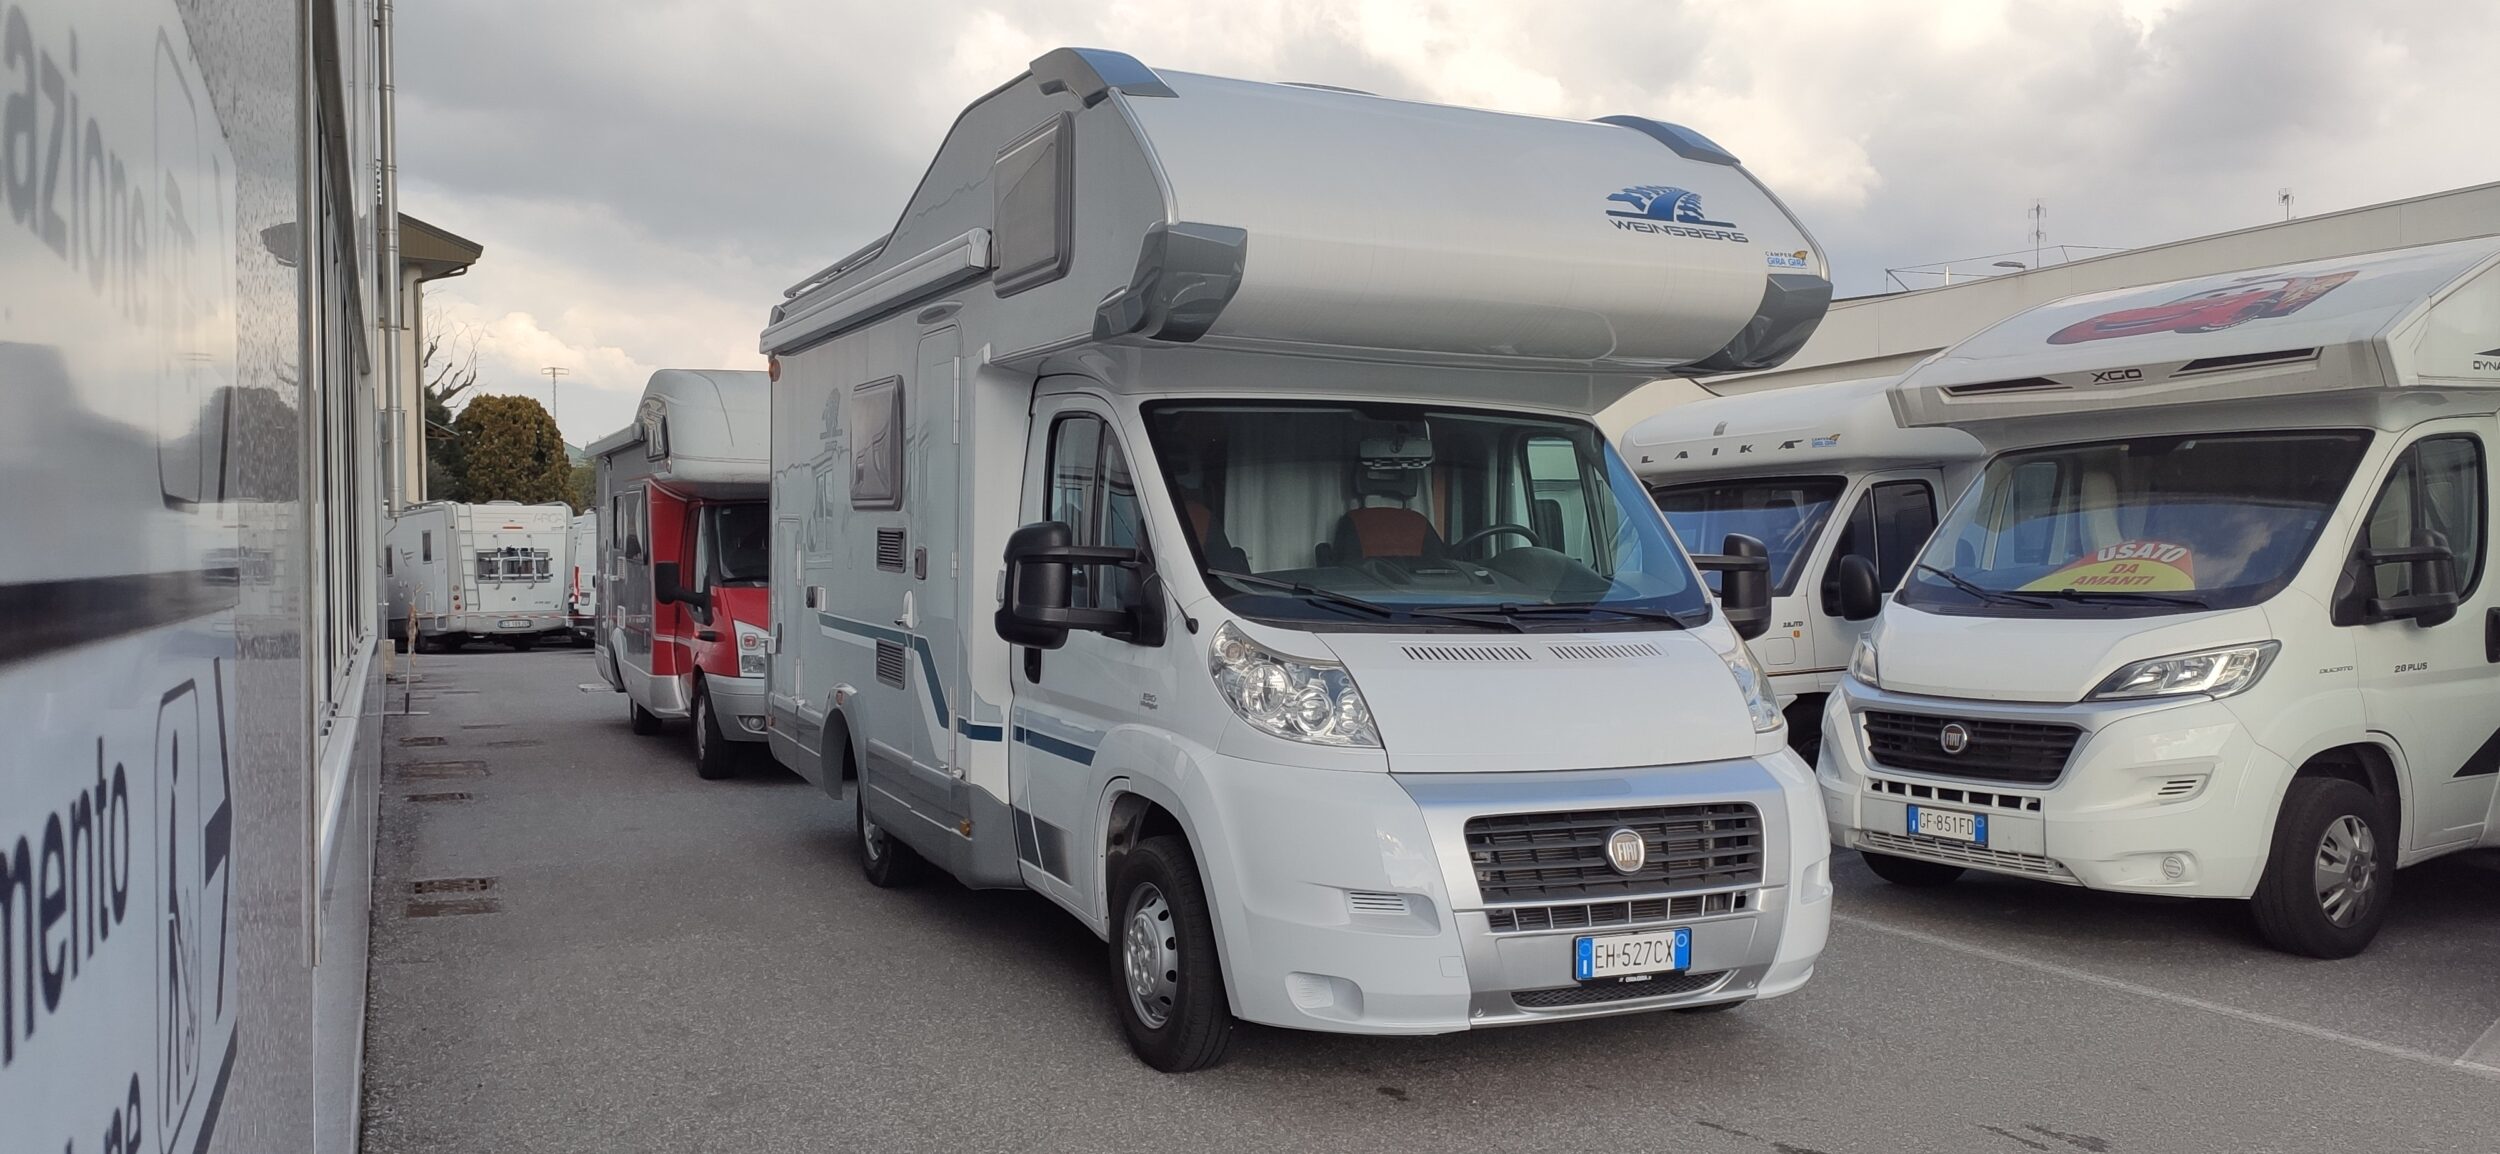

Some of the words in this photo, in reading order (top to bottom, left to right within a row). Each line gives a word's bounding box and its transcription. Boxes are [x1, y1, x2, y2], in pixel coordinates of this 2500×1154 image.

[1609, 219, 1749, 243] WEINSBERG
[2090, 368, 2142, 383] XGO
[1641, 439, 1804, 464] LAIKA
[2097, 543, 2187, 562] USATO
[2109, 563, 2139, 574] DA
[2070, 576, 2155, 585] AMANTI
[2407, 662, 2428, 671] PLUS
[1946, 732, 1961, 746] FIAT
[1616, 842, 1638, 861] FIAT
